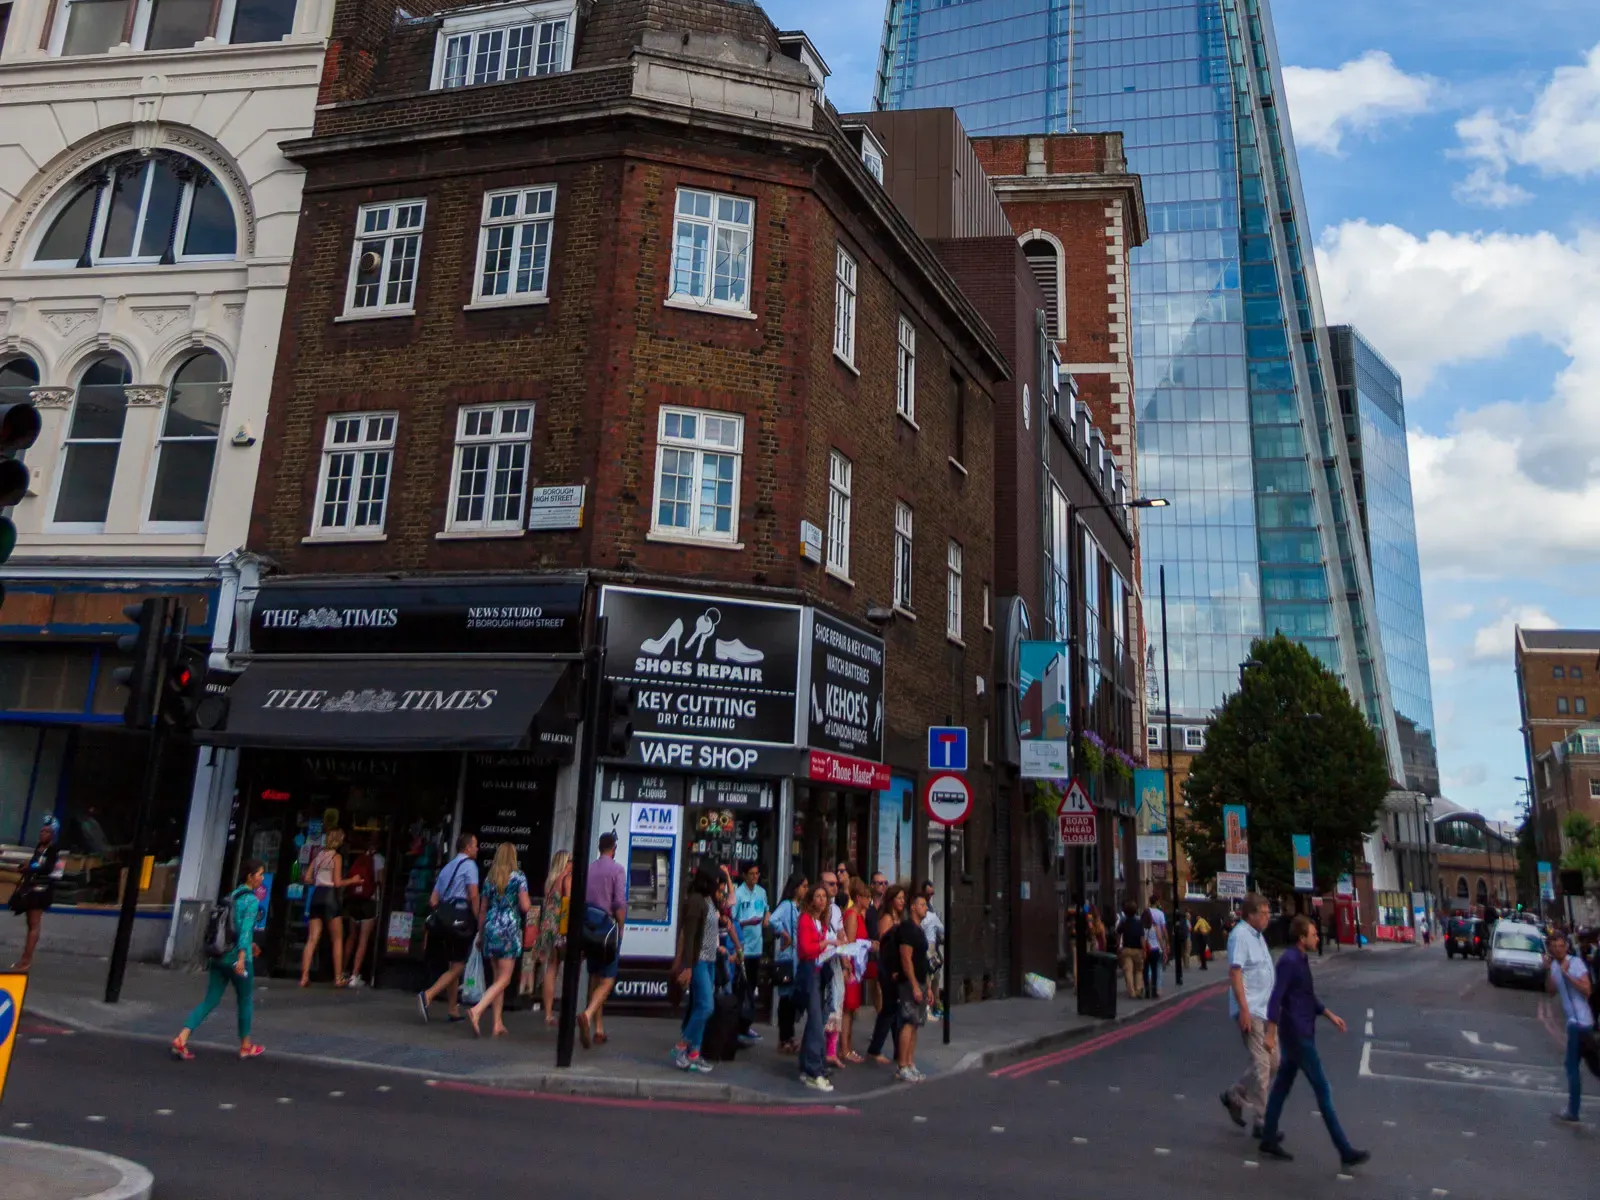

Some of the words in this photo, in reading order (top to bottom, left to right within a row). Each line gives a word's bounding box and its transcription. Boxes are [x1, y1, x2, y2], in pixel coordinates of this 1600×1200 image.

[262, 609, 298, 627] THE
[342, 608, 398, 627] TIMES
[468, 607, 499, 618] NEWS
[501, 606, 542, 618] STUDIO
[467, 620, 474, 628] 21
[476, 619, 514, 628] BOROUGH
[516, 619, 534, 628] HIGH
[535, 618, 564, 628] STREET
[815, 623, 829, 644] SHOE
[830, 630, 847, 650] REPAIR
[852, 639, 861, 657] KEY
[861, 644, 882, 666] CUTTING
[635, 657, 692, 676] SHOES
[697, 663, 763, 683] REPAIR
[826, 653, 844, 676] WATCH
[844, 660, 870, 684] BATTERIES
[262, 690, 328, 710] THE
[398, 690, 498, 710] TIMES
[637, 690, 674, 711] KEY
[676, 694, 756, 718] CUTTING
[826, 683, 868, 727] KEHOE'S
[657, 712, 679, 725] DRY
[682, 714, 736, 730] CLEANING
[824, 718, 830, 735] of
[830, 720, 852, 742] LONDON
[852, 726, 868, 744] BRIDGE
[640, 742, 694, 766] VAPE
[699, 748, 758, 770] SHOP
[642, 776, 658, 787] VAPE
[832, 759, 852, 782] Phone
[852, 764, 872, 785] Master
[638, 787, 667, 799] E-LIQUIDS
[718, 782, 732, 791] BEST
[718, 792, 724, 802] IN
[726, 793, 748, 803] LONDON
[638, 808, 672, 824] ATM
[615, 981, 668, 995] CUTTING
